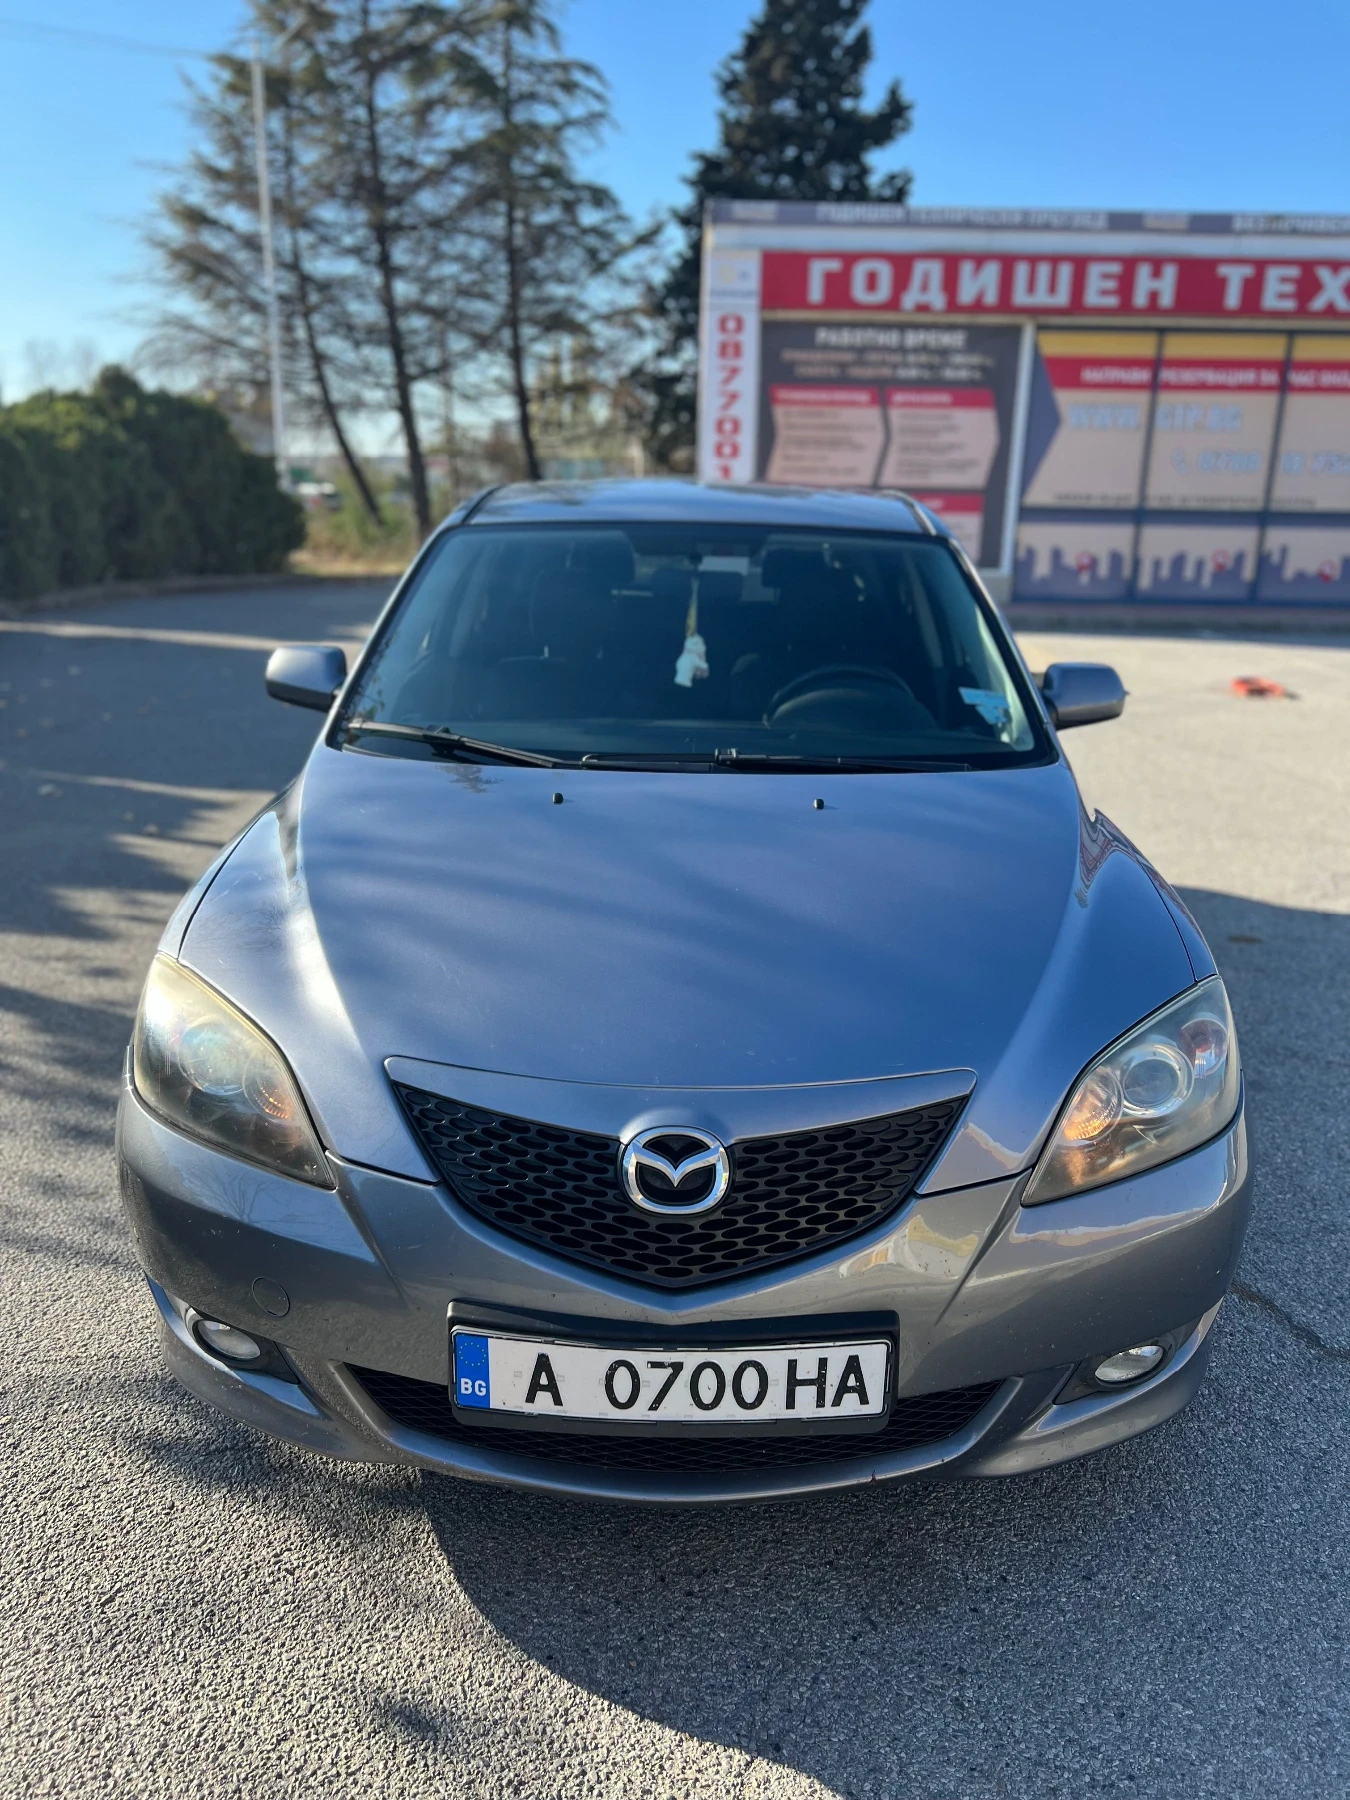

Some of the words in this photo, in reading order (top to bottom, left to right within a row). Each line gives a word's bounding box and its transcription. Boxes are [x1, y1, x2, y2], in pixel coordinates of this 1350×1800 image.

[807, 257, 1180, 311] ГОДИШЕН
[1216, 262, 1350, 312] ТЕХ
[460, 1378, 487, 1397] BG
[524, 1353, 564, 1407] A
[604, 1359, 769, 1412] 0700
[785, 1354, 870, 1411] HA
